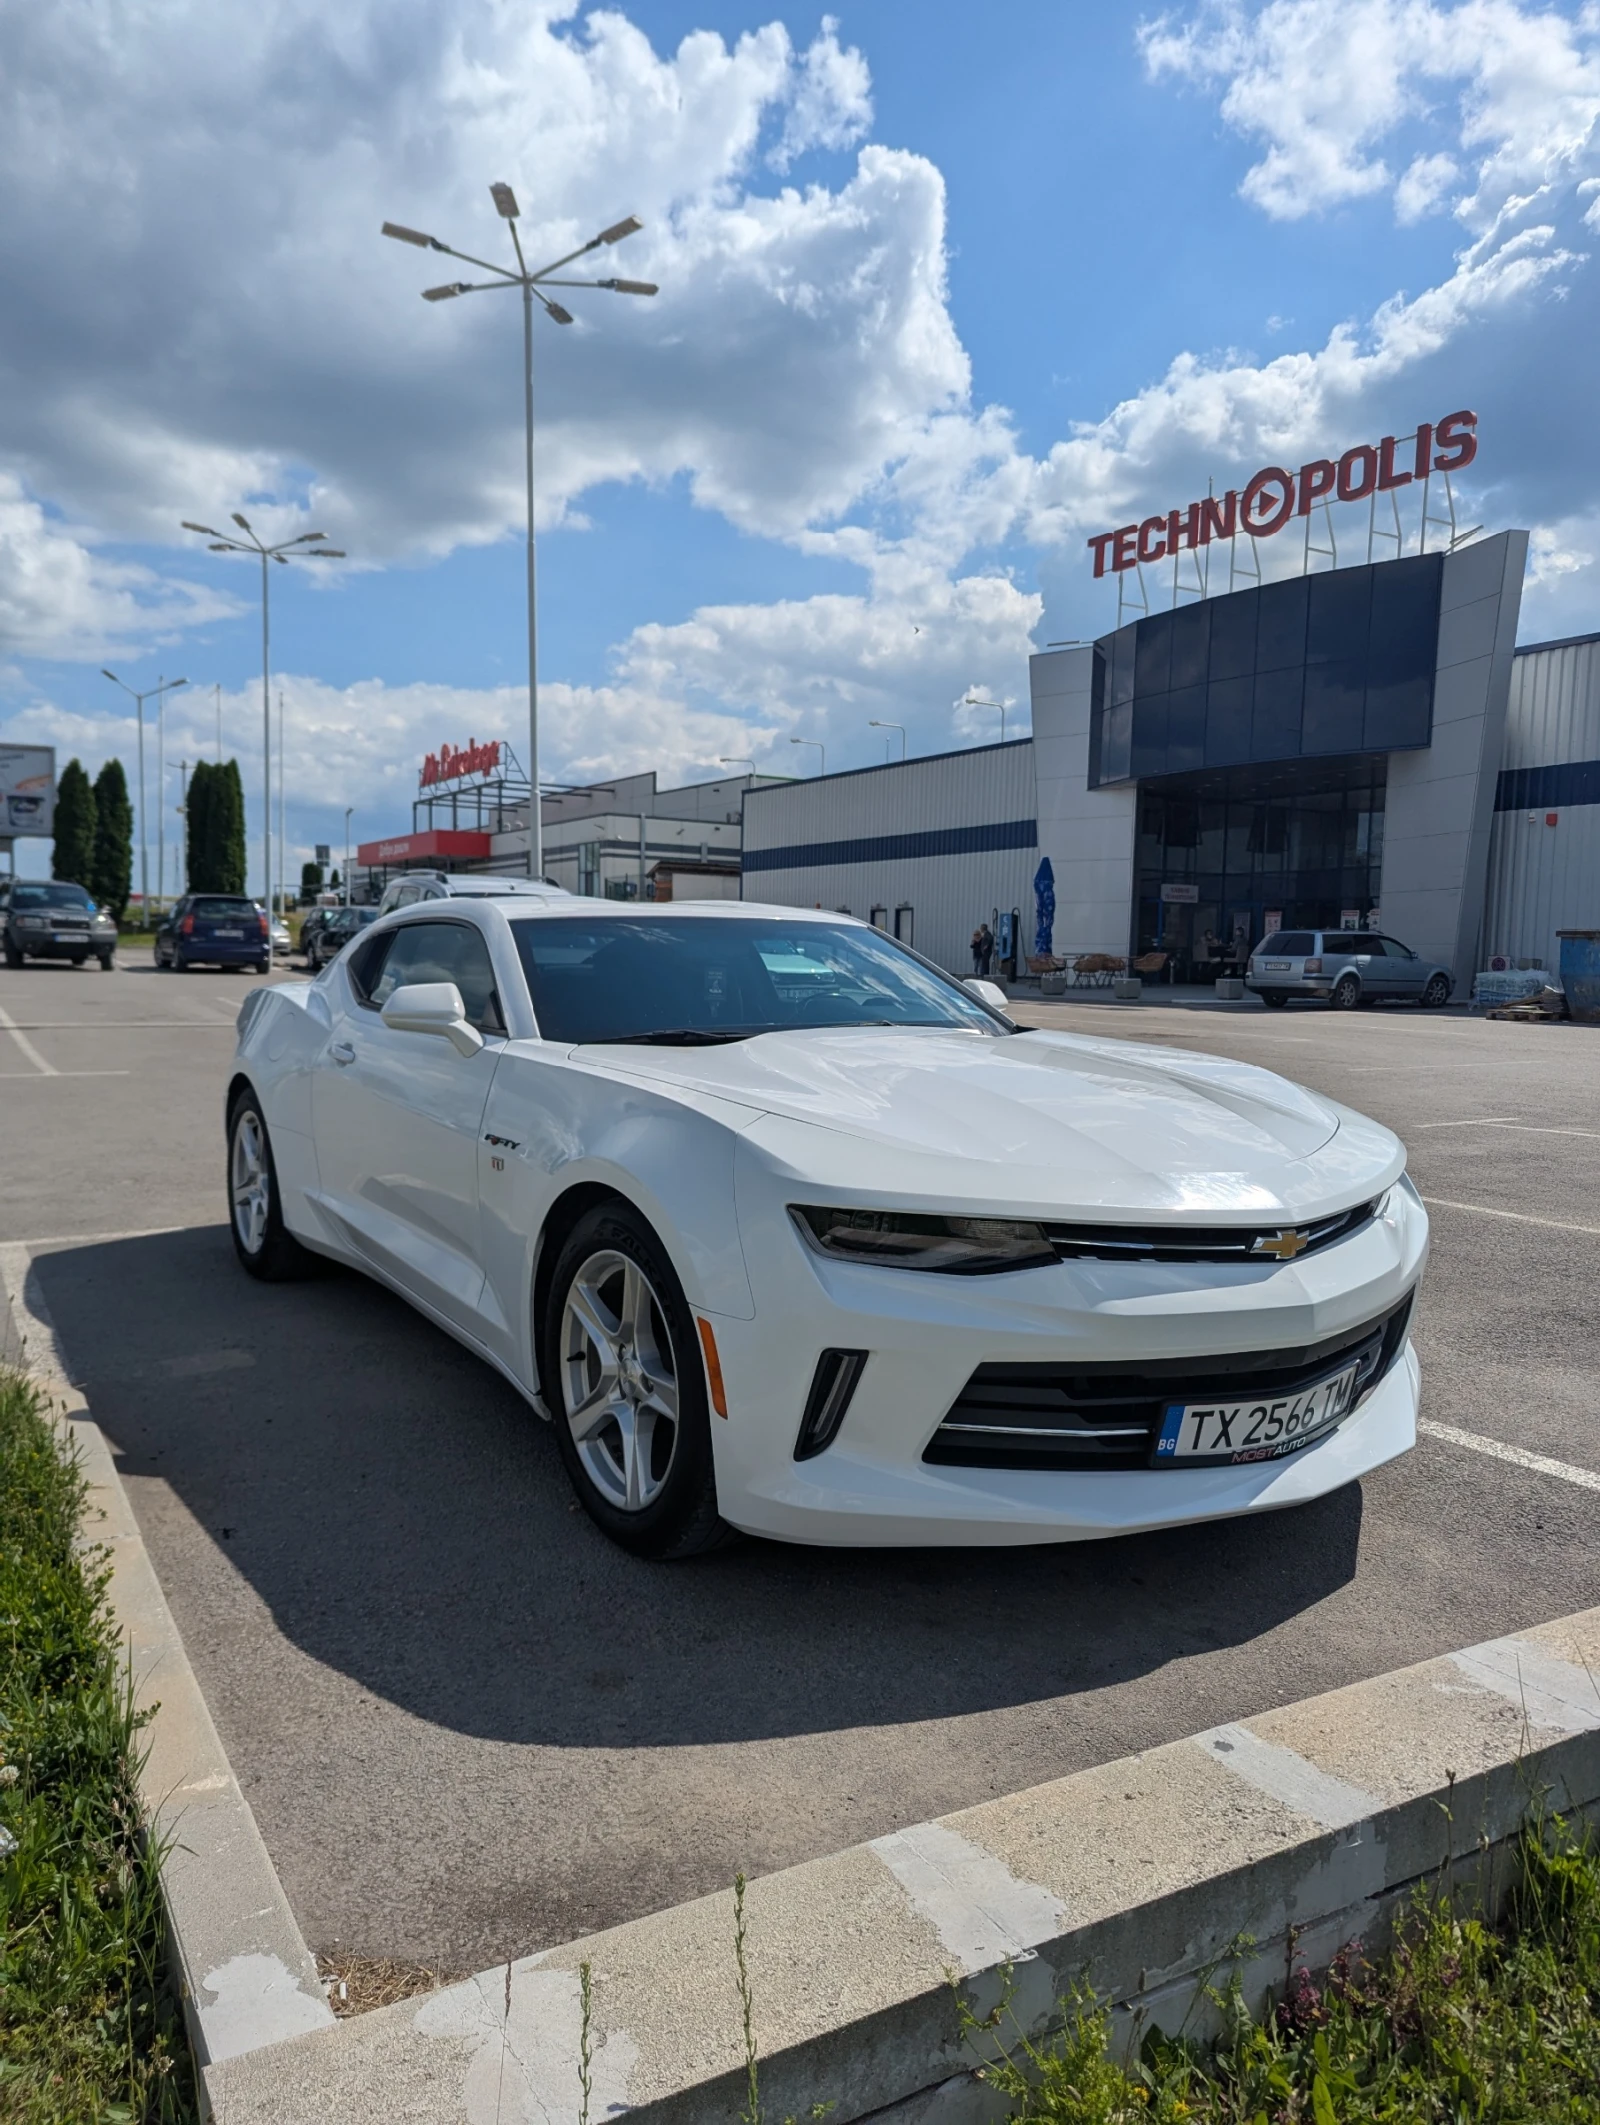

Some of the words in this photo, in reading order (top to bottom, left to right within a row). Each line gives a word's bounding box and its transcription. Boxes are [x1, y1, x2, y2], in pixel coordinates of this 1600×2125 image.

[1087, 409, 1478, 578] TECHNOPOLIS
[1157, 1438, 1176, 1451] BG
[1190, 1408, 1240, 1450] TX
[1241, 1391, 1316, 1446] 2566
[1322, 1374, 1352, 1419] TM
